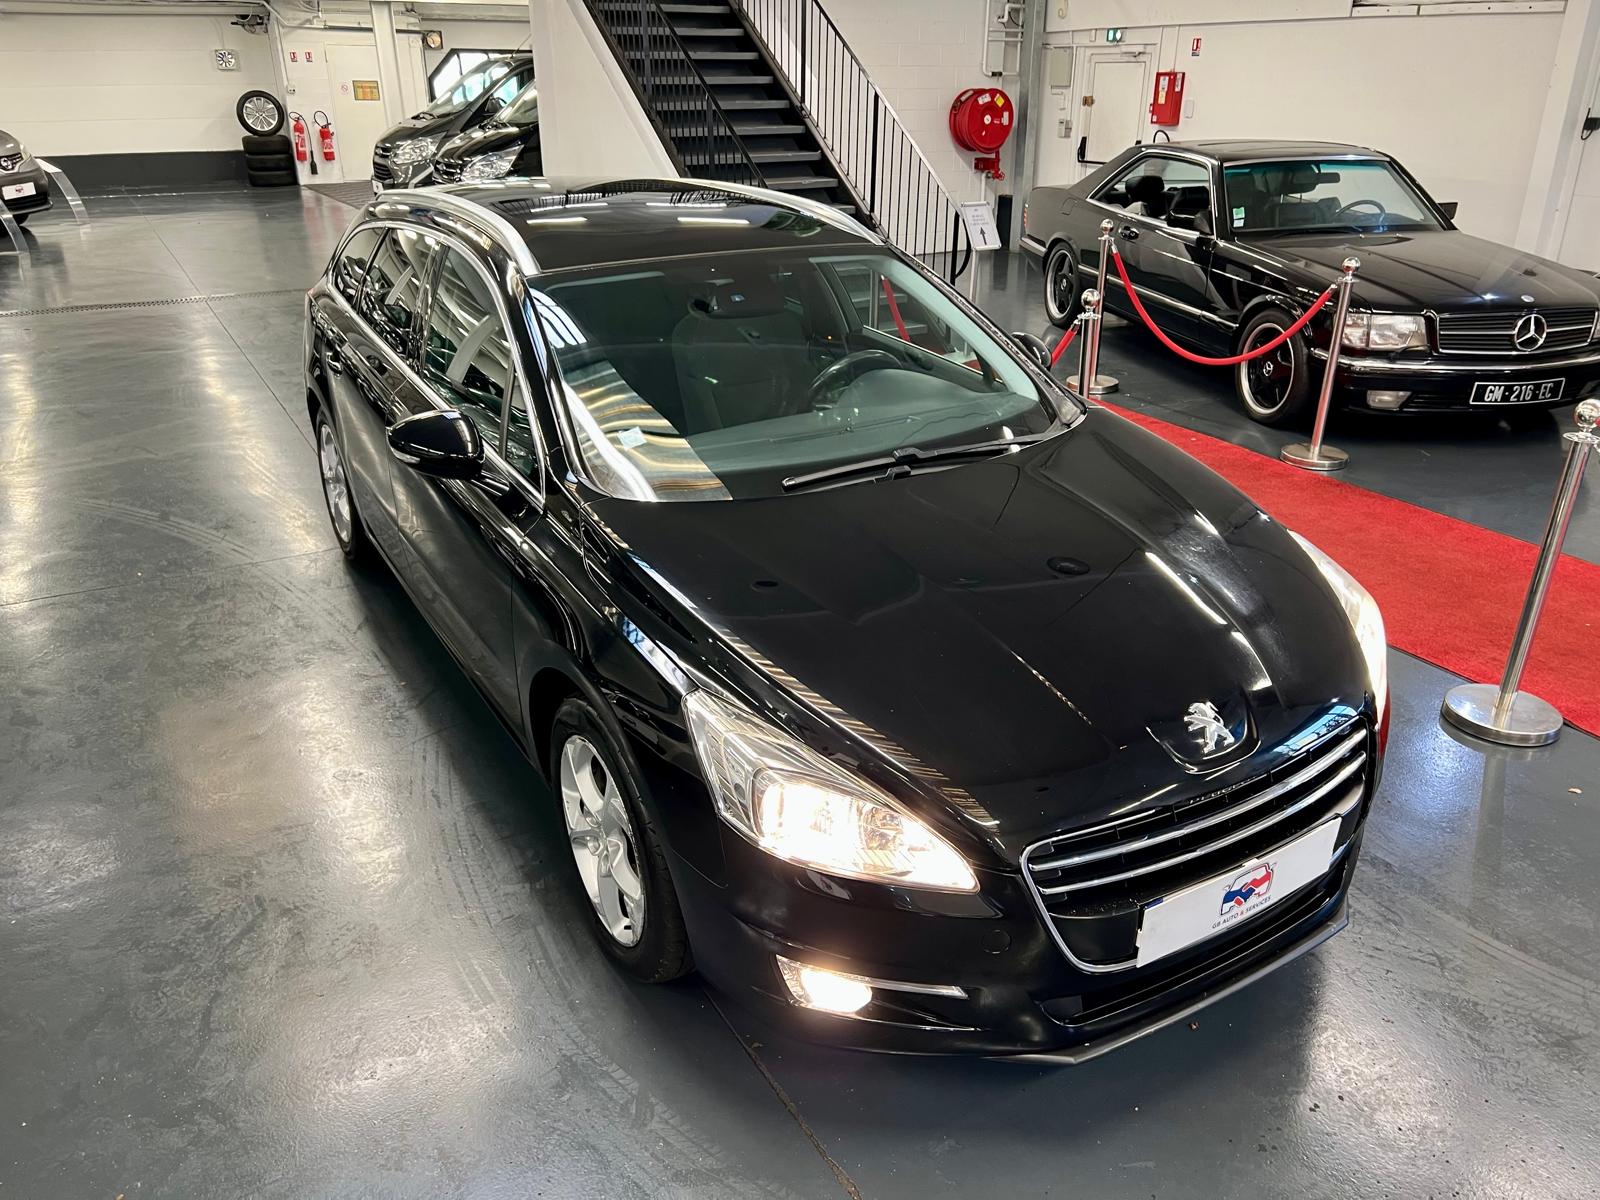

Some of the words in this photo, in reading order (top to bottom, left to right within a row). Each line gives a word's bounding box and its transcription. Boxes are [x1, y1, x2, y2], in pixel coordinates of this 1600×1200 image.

[1212, 921, 1221, 929] GB
[1222, 912, 1239, 924] AUTO
[1245, 896, 1271, 912] SERVICES
